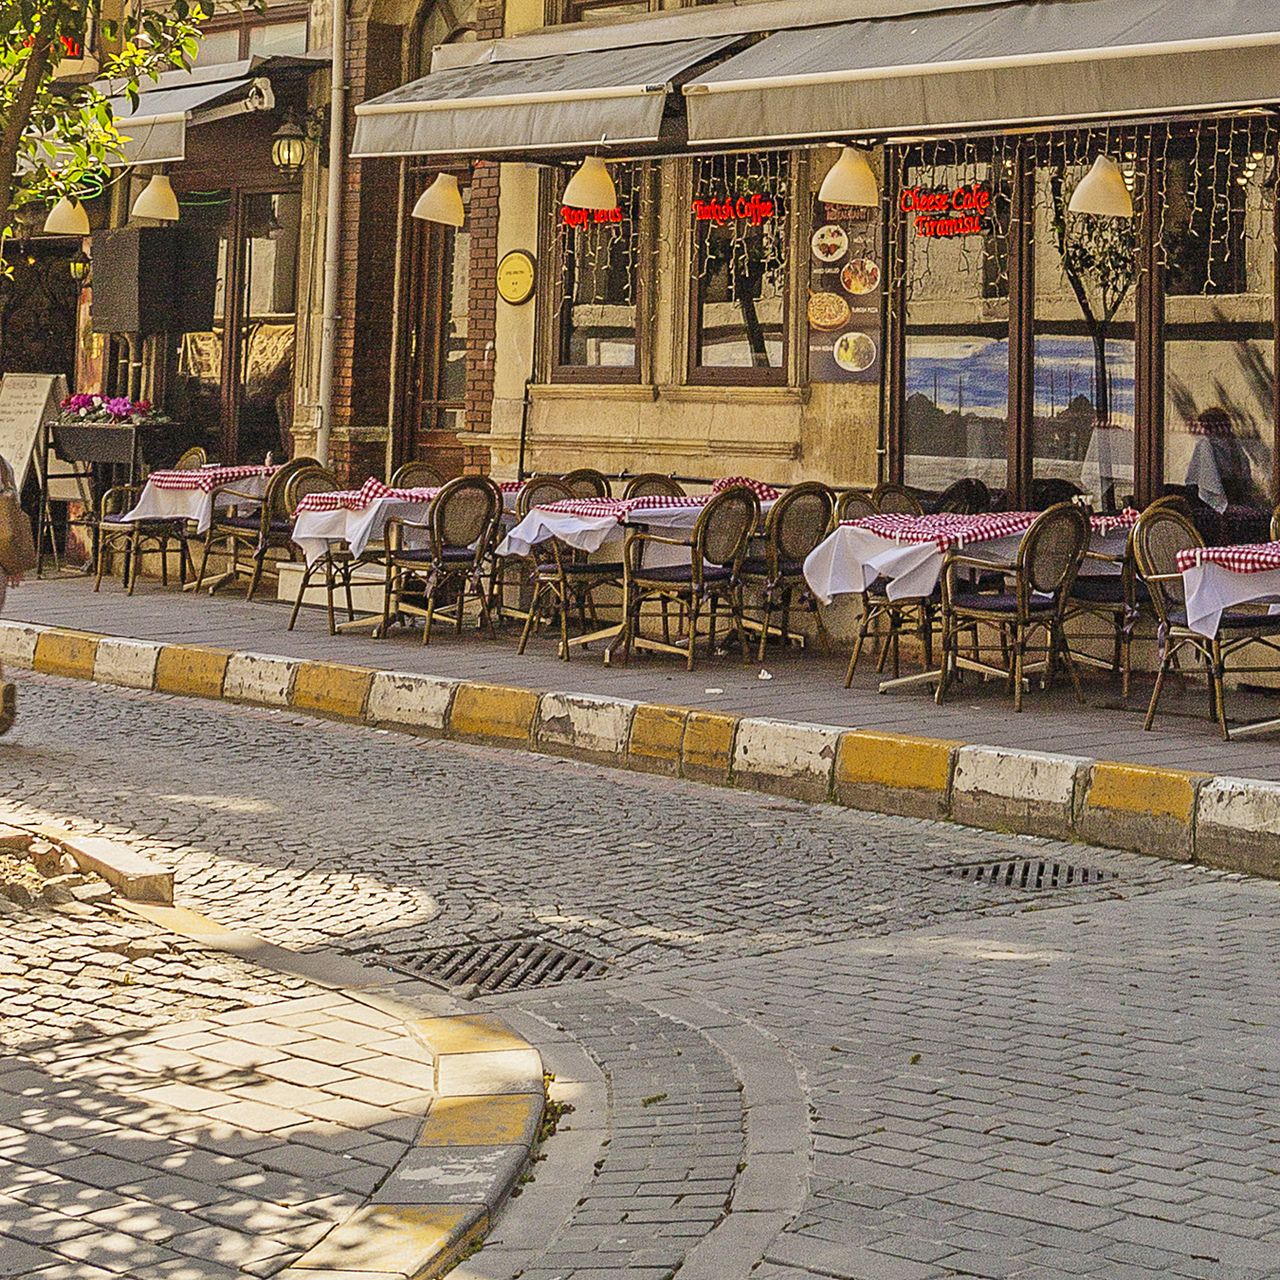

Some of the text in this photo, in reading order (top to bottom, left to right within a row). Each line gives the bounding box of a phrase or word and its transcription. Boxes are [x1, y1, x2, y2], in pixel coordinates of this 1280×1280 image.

[692, 194, 774, 226] Turkish Coffee
[901, 181, 991, 215] Cheese Cake
[913, 212, 982, 238] Tiramisu
